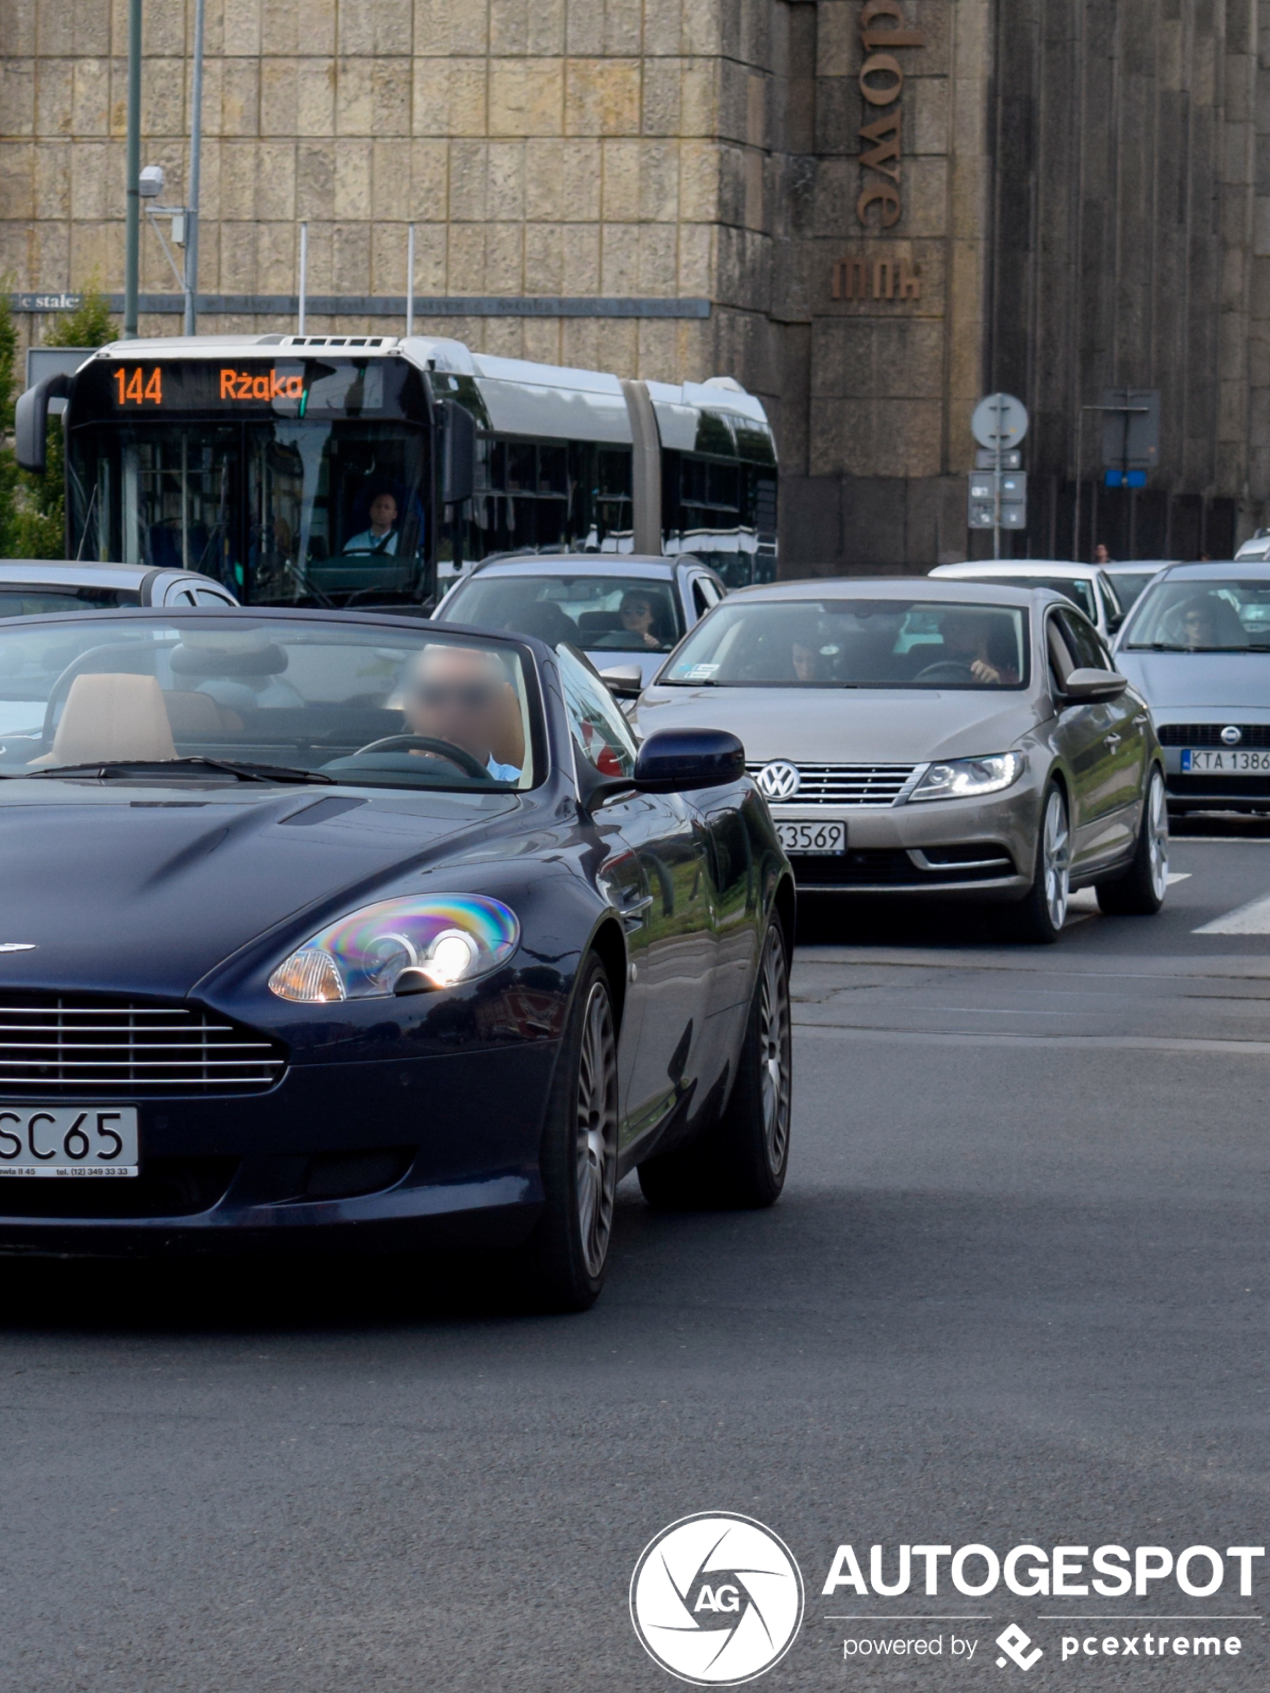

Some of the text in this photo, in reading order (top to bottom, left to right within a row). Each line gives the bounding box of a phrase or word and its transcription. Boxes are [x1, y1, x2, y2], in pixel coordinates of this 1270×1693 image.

[113, 367, 303, 405] 144 Rżąka
[1192, 752, 1270, 769] KTA 1386
[757, 761, 799, 799] VW
[25, 1167, 36, 1176] 45
[56, 1168, 70, 1176] tel.
[71, 1167, 86, 1177] (12)
[87, 1167, 104, 1176] 349
[105, 1167, 116, 1176] 33
[117, 1167, 129, 1176] 33
